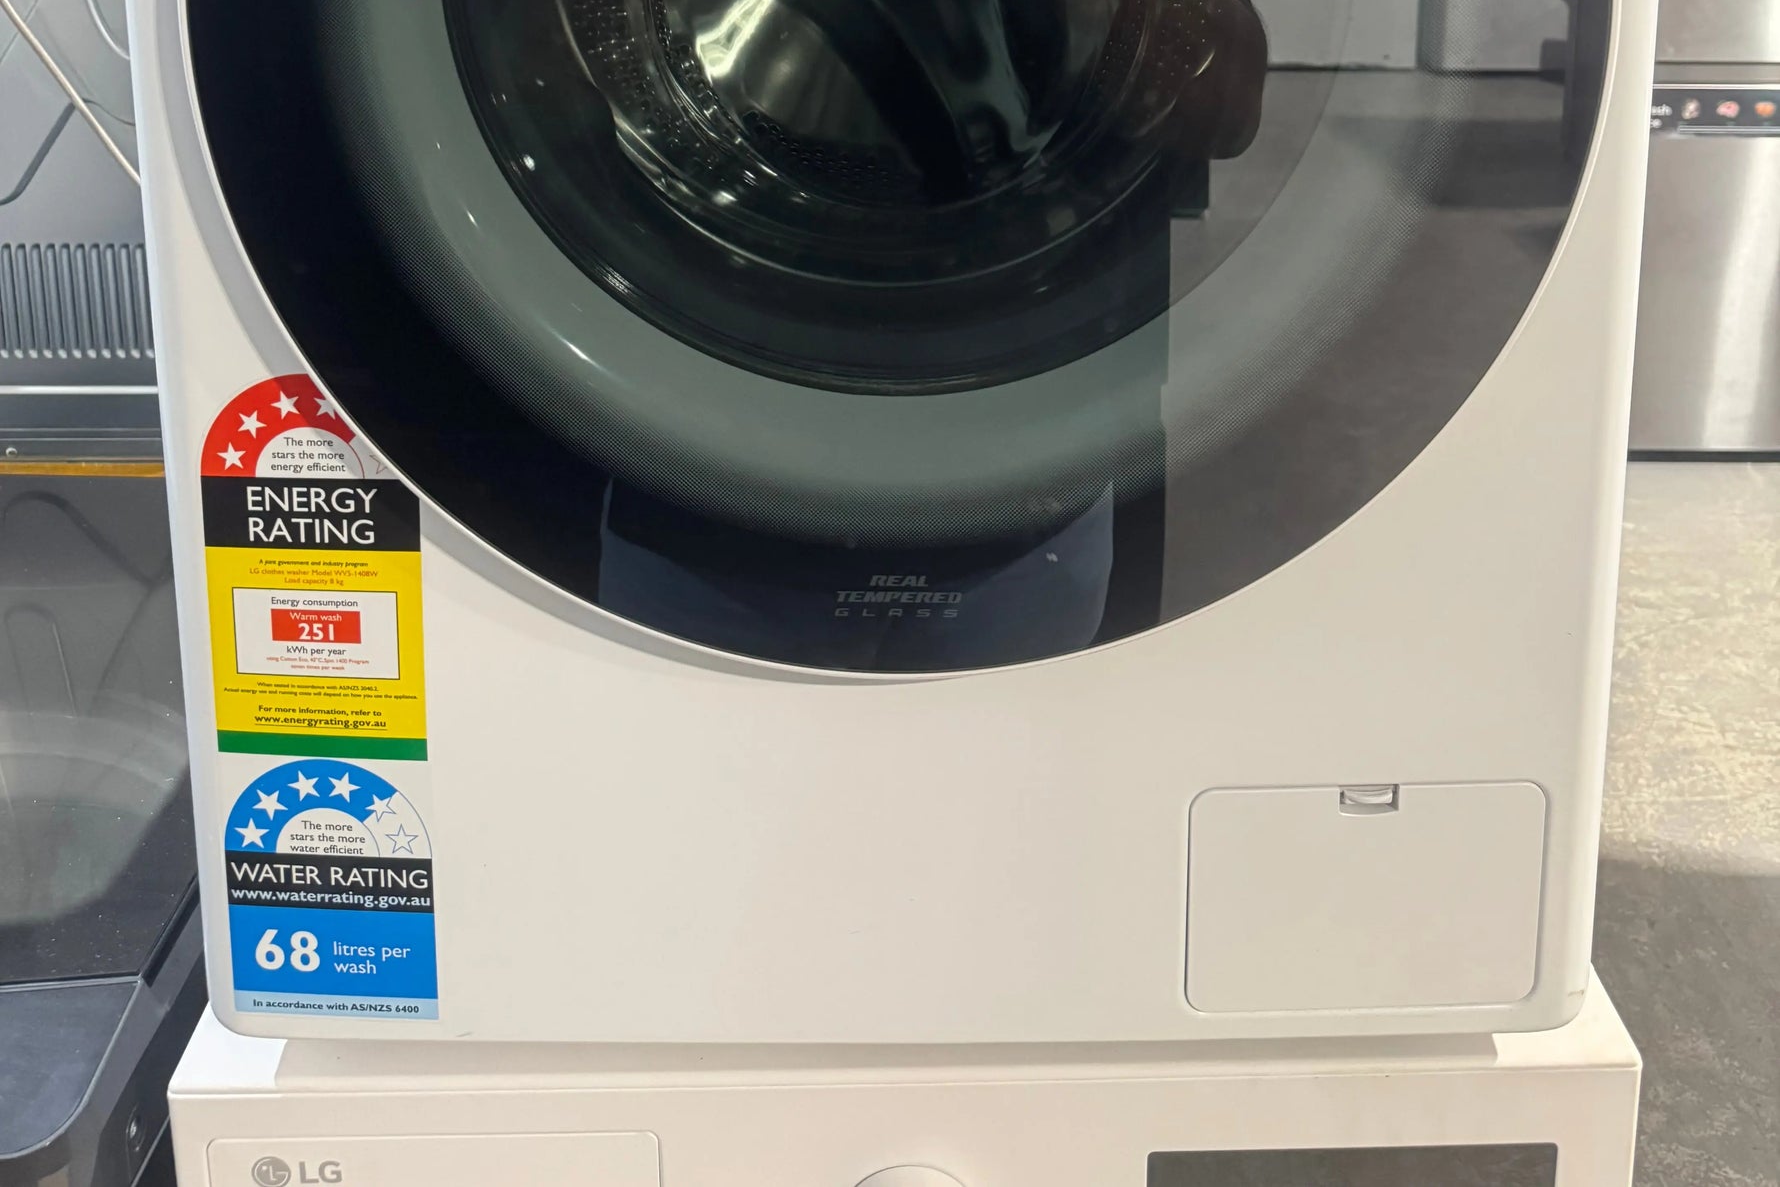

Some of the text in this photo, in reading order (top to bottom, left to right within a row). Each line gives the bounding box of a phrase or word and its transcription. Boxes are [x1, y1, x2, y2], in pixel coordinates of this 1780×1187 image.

[284, 437, 304, 446] The
[271, 462, 346, 473] energy efficient
[246, 486, 378, 514] ENERGY
[248, 517, 375, 544] RATING
[869, 575, 928, 587] REAL
[271, 597, 358, 607] Energy consumption
[836, 591, 962, 603] TEMPERED
[290, 612, 341, 621] Warm wash
[834, 608, 959, 618] GLASS
[299, 623, 335, 640] 251
[287, 646, 308, 654] kWh
[311, 648, 325, 656] per
[299, 706, 349, 716] information,
[255, 715, 386, 728] www.energyrating.gov.au
[301, 820, 353, 831] The more
[290, 832, 366, 843] stars the more
[290, 845, 364, 855] water efficient
[231, 862, 428, 889] WATER RATING
[231, 889, 431, 908] www.waterrating.gov.au
[255, 929, 321, 972] 68
[333, 941, 411, 961] litres per
[334, 960, 377, 974] wash
[266, 1001, 323, 1010] accordance
[326, 1001, 348, 1010] with
[350, 1003, 392, 1012] AS/NZS
[395, 1005, 419, 1013] 6400
[299, 1161, 342, 1183] LG
